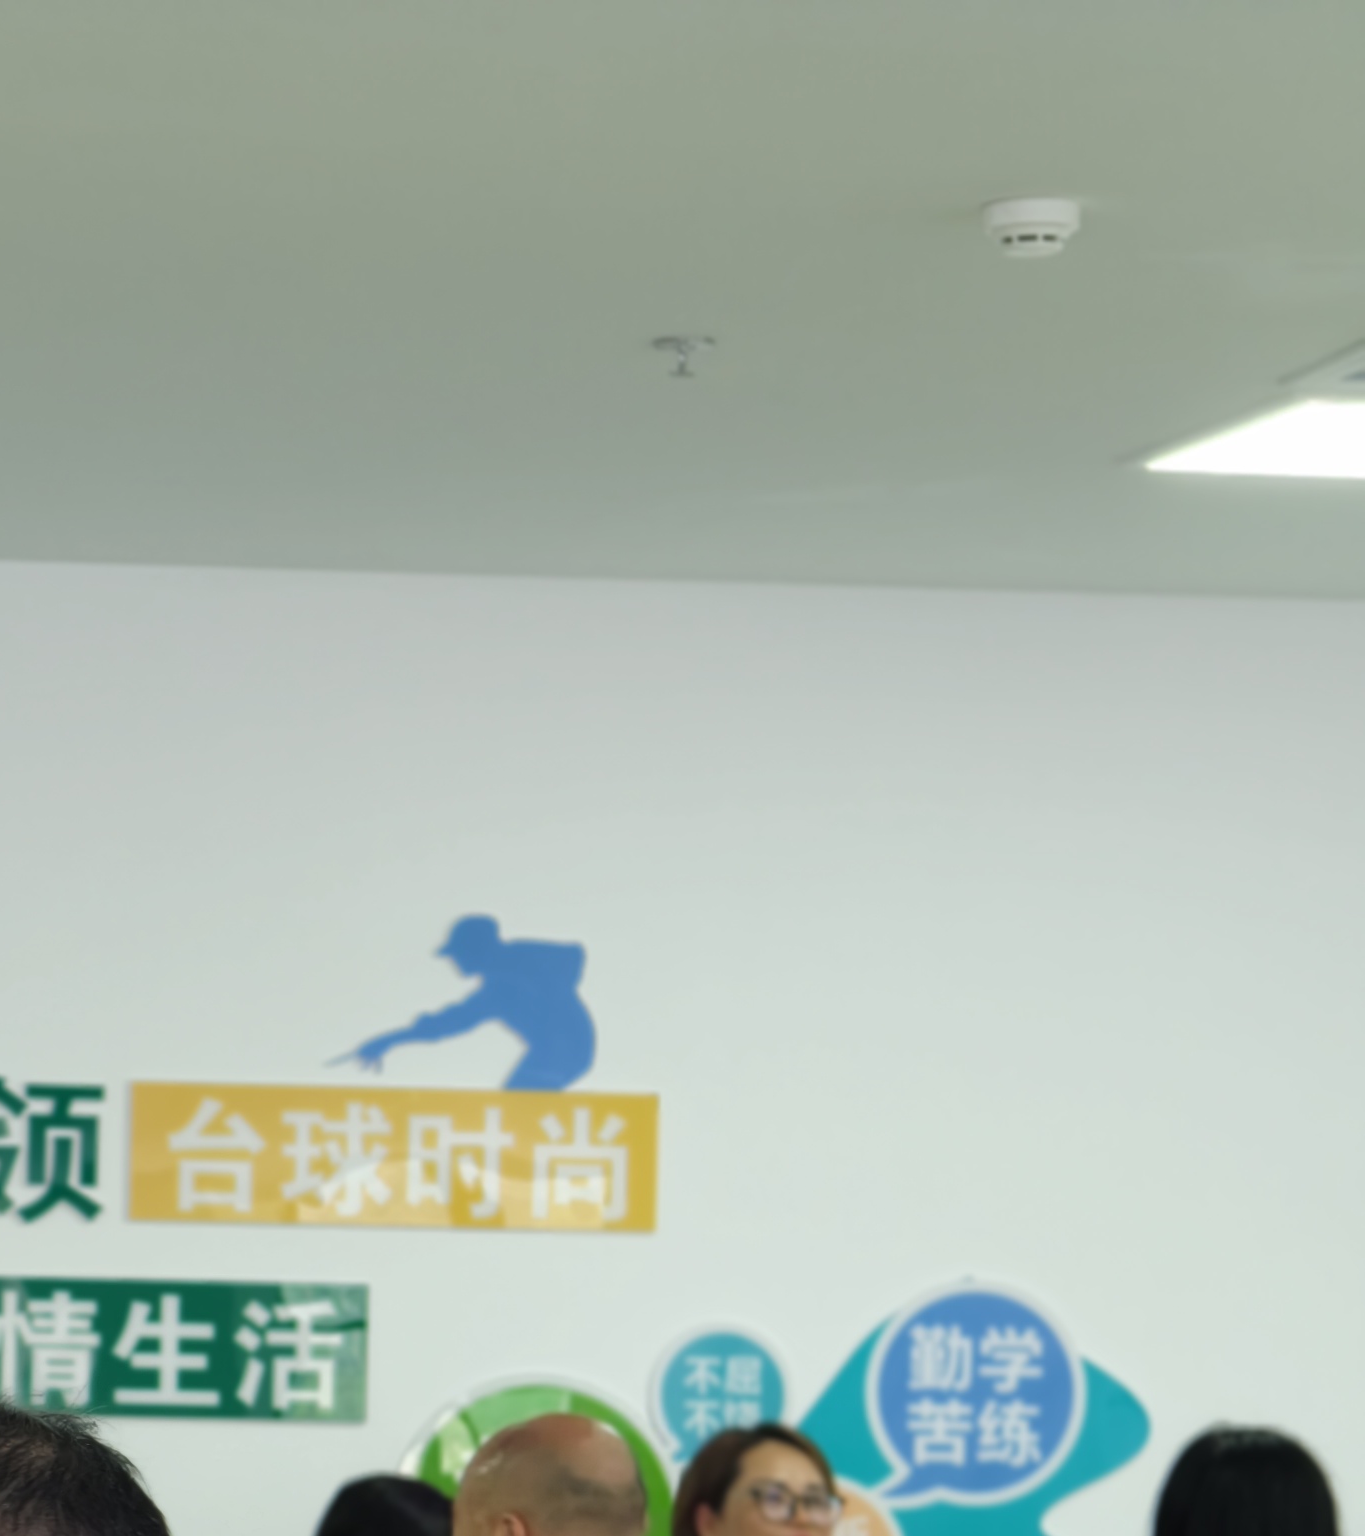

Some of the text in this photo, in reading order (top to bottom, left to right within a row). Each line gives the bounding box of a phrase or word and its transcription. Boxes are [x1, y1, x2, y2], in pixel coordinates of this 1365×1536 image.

[167, 1096, 629, 1223] 台球时尚
[908, 1323, 1044, 1394] 勤学
[906, 1397, 1043, 1468] 苦练
